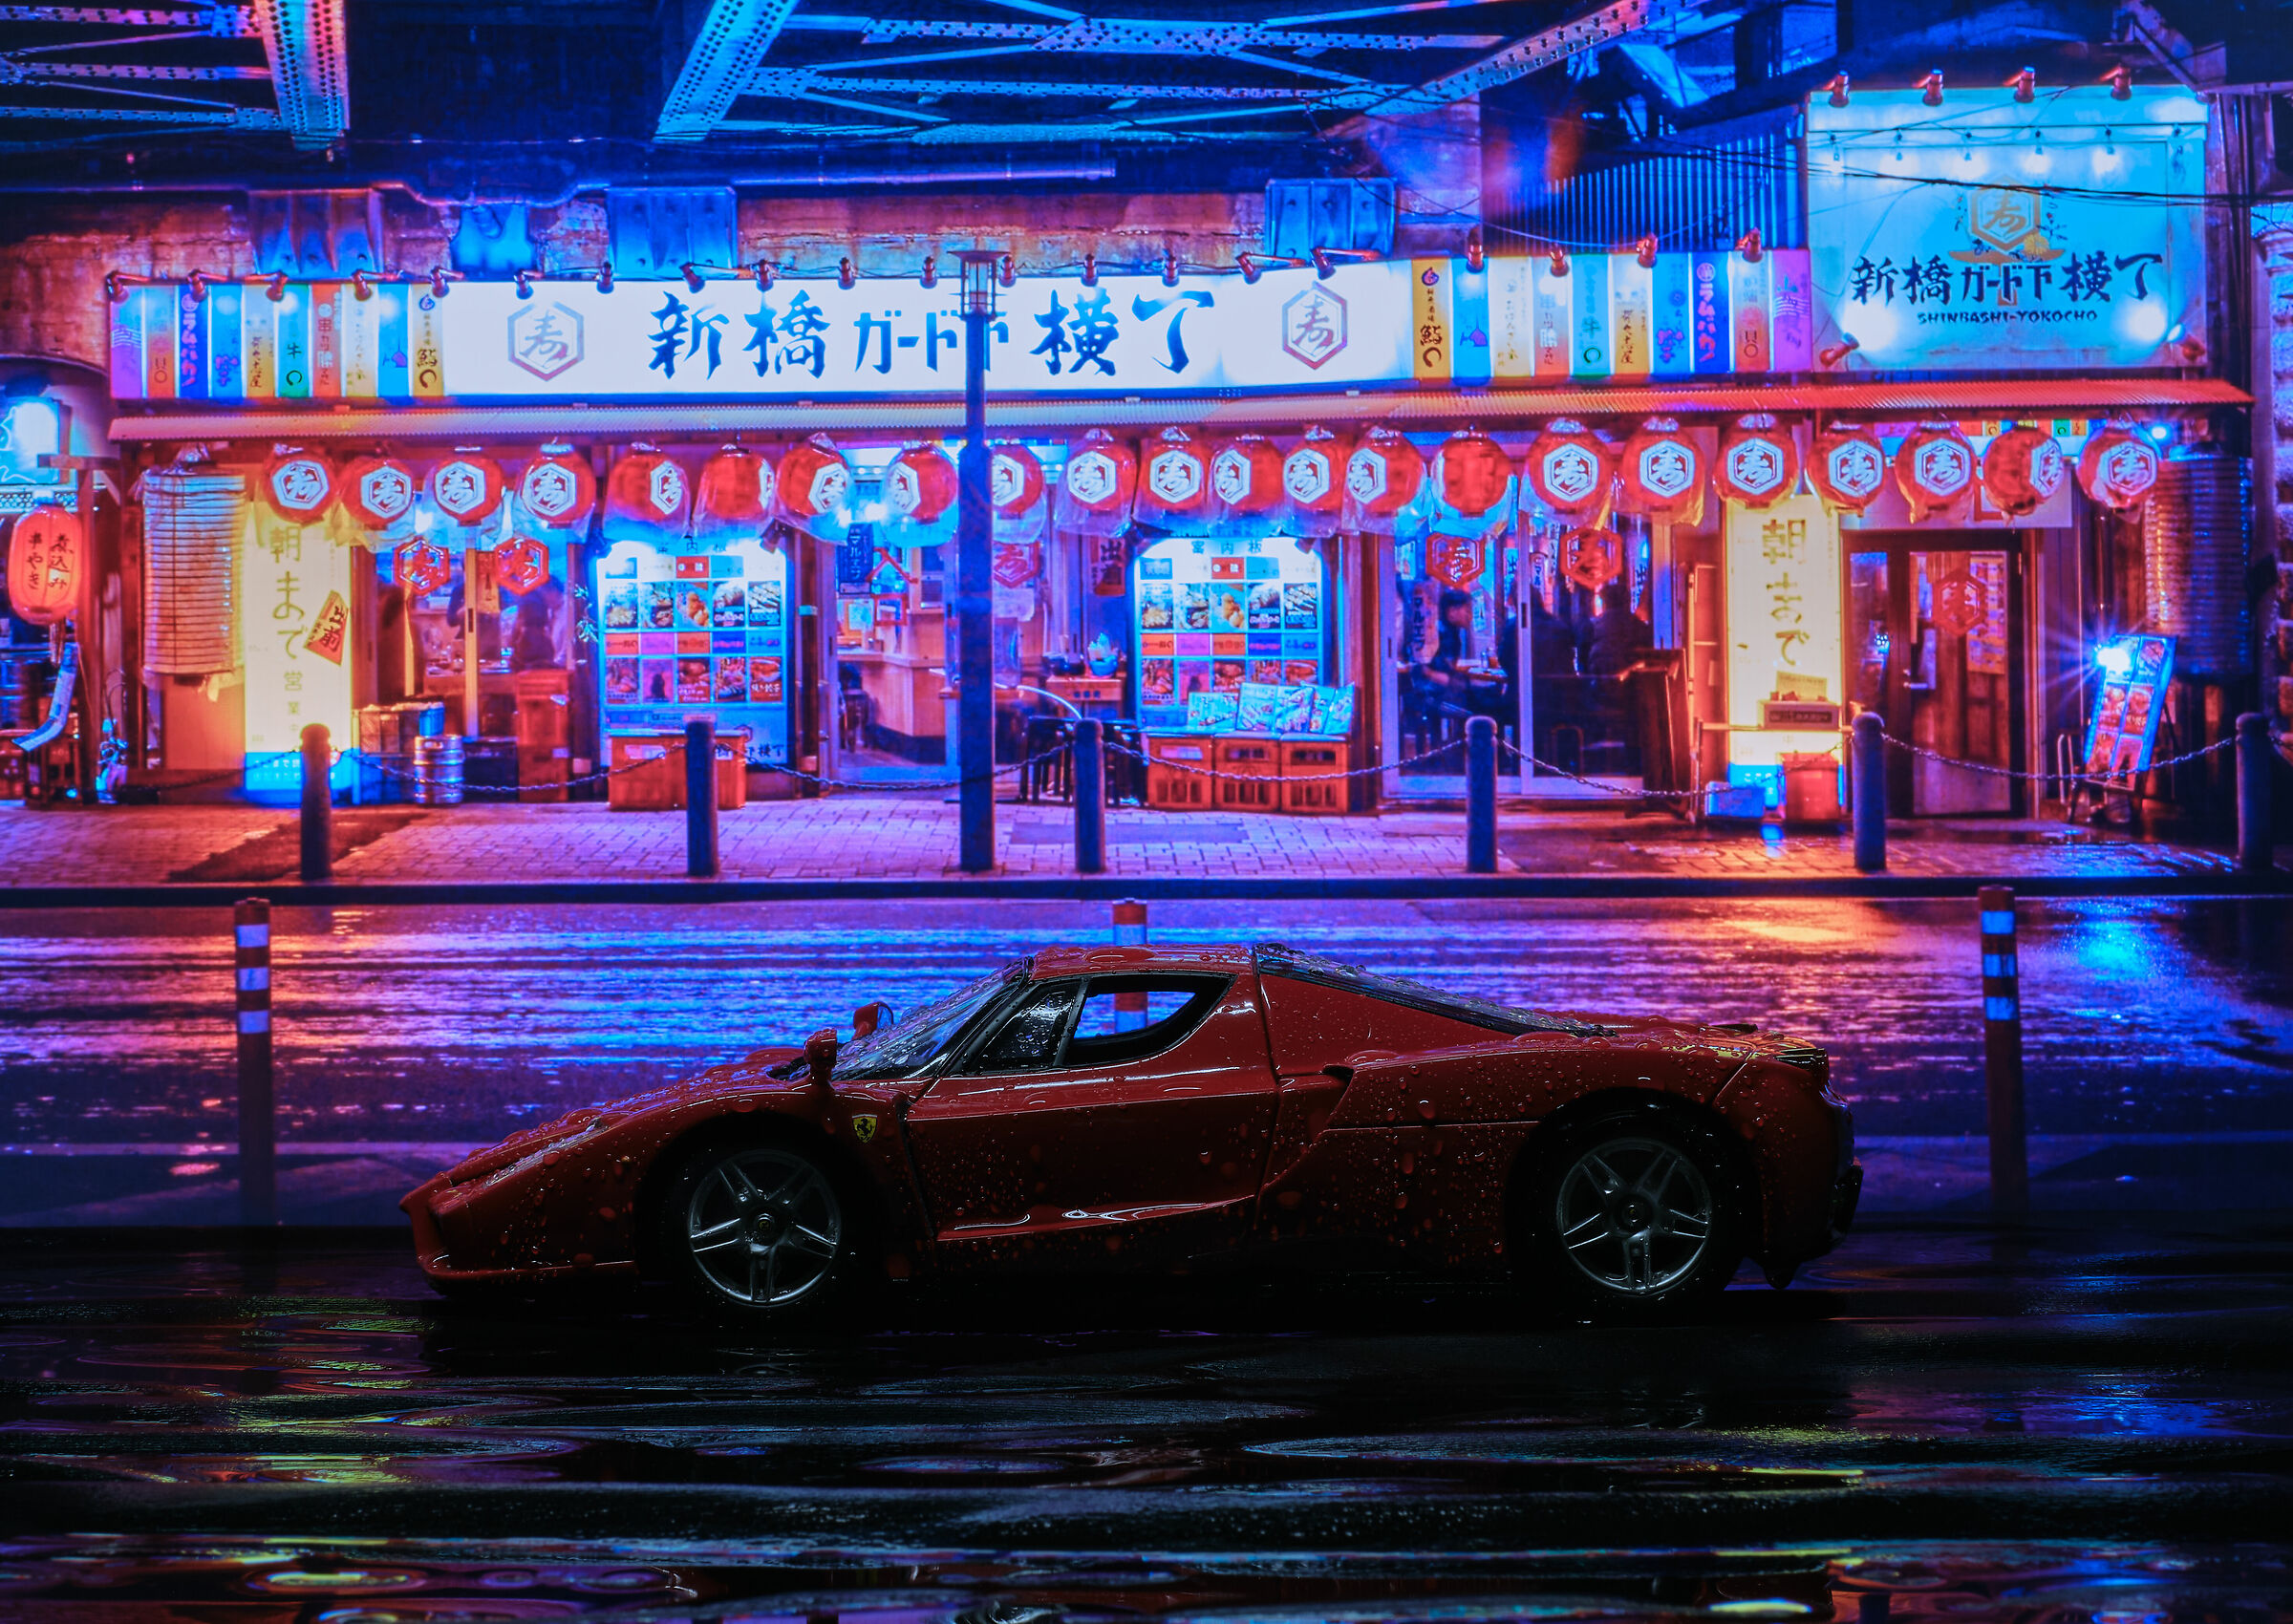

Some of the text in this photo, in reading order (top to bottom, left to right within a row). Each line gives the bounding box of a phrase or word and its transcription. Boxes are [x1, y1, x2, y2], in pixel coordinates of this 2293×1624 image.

[1985, 193, 2026, 233] 寿
[1852, 249, 2163, 306] 新橋ガード下横丁
[1918, 310, 2098, 326] SHINBASHI-YOKOCHO
[27, 532, 44, 590] 串やき
[49, 533, 75, 590] 煮込み
